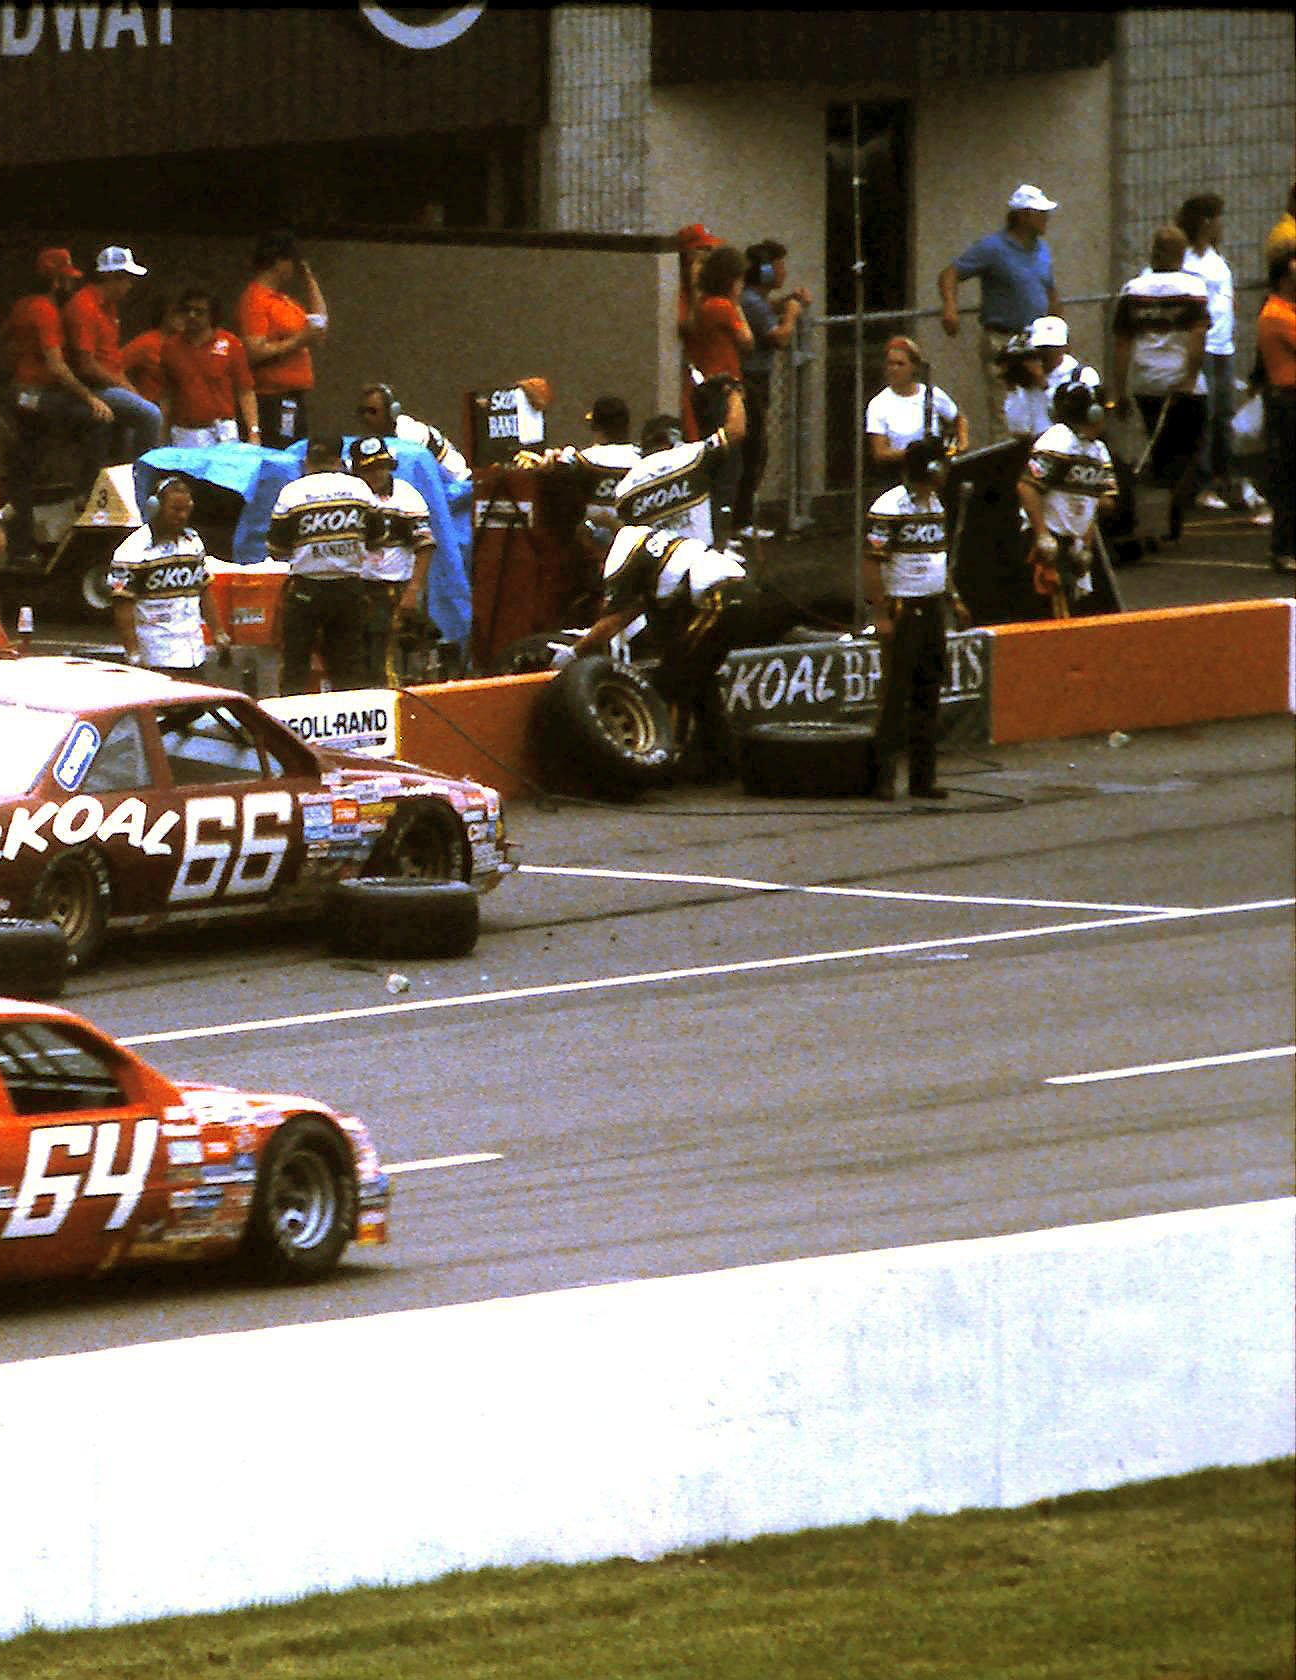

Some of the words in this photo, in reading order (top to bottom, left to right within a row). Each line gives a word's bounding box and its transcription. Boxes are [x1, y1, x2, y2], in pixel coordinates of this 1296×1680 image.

[97, 489, 109, 509] 3
[632, 479, 691, 517] SKOAL
[168, 792, 293, 902] 66
[1, 1118, 160, 1240] 64
